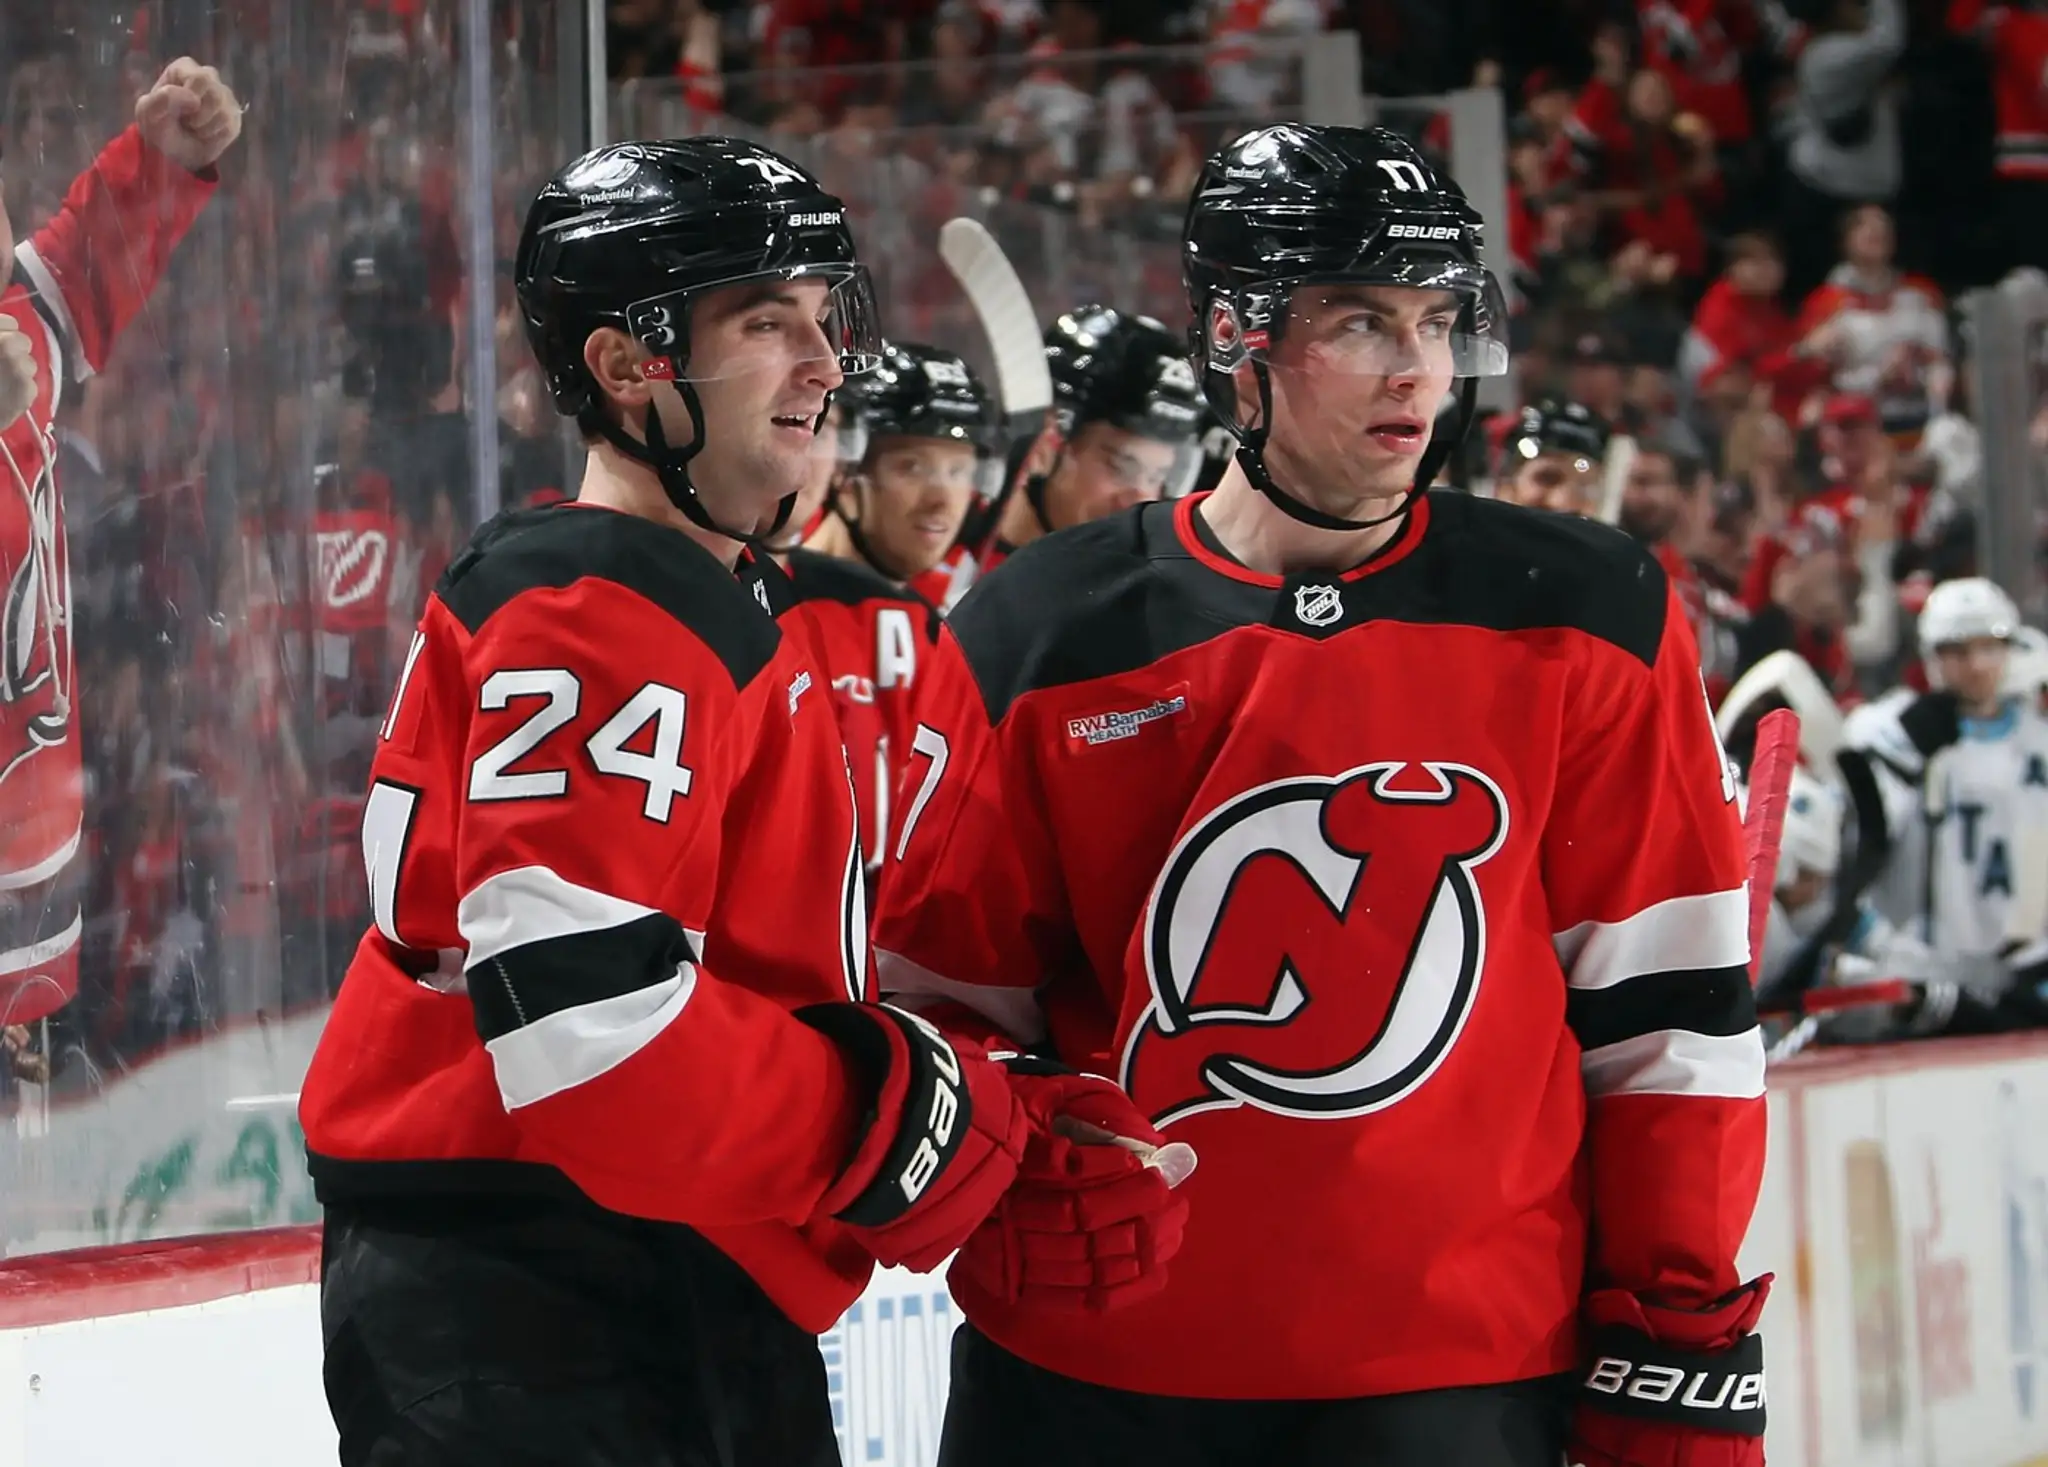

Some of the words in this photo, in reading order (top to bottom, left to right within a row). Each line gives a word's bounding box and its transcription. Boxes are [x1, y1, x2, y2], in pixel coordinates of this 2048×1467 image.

[580, 186, 635, 208] Prudential
[788, 212, 841, 227] BAUER
[1387, 224, 1460, 240] BAUER
[877, 608, 915, 688] A
[467, 667, 693, 824] 24
[1088, 723, 1138, 743] HEALTH
[896, 722, 949, 862] 7
[882, 1002, 961, 1204] BAU
